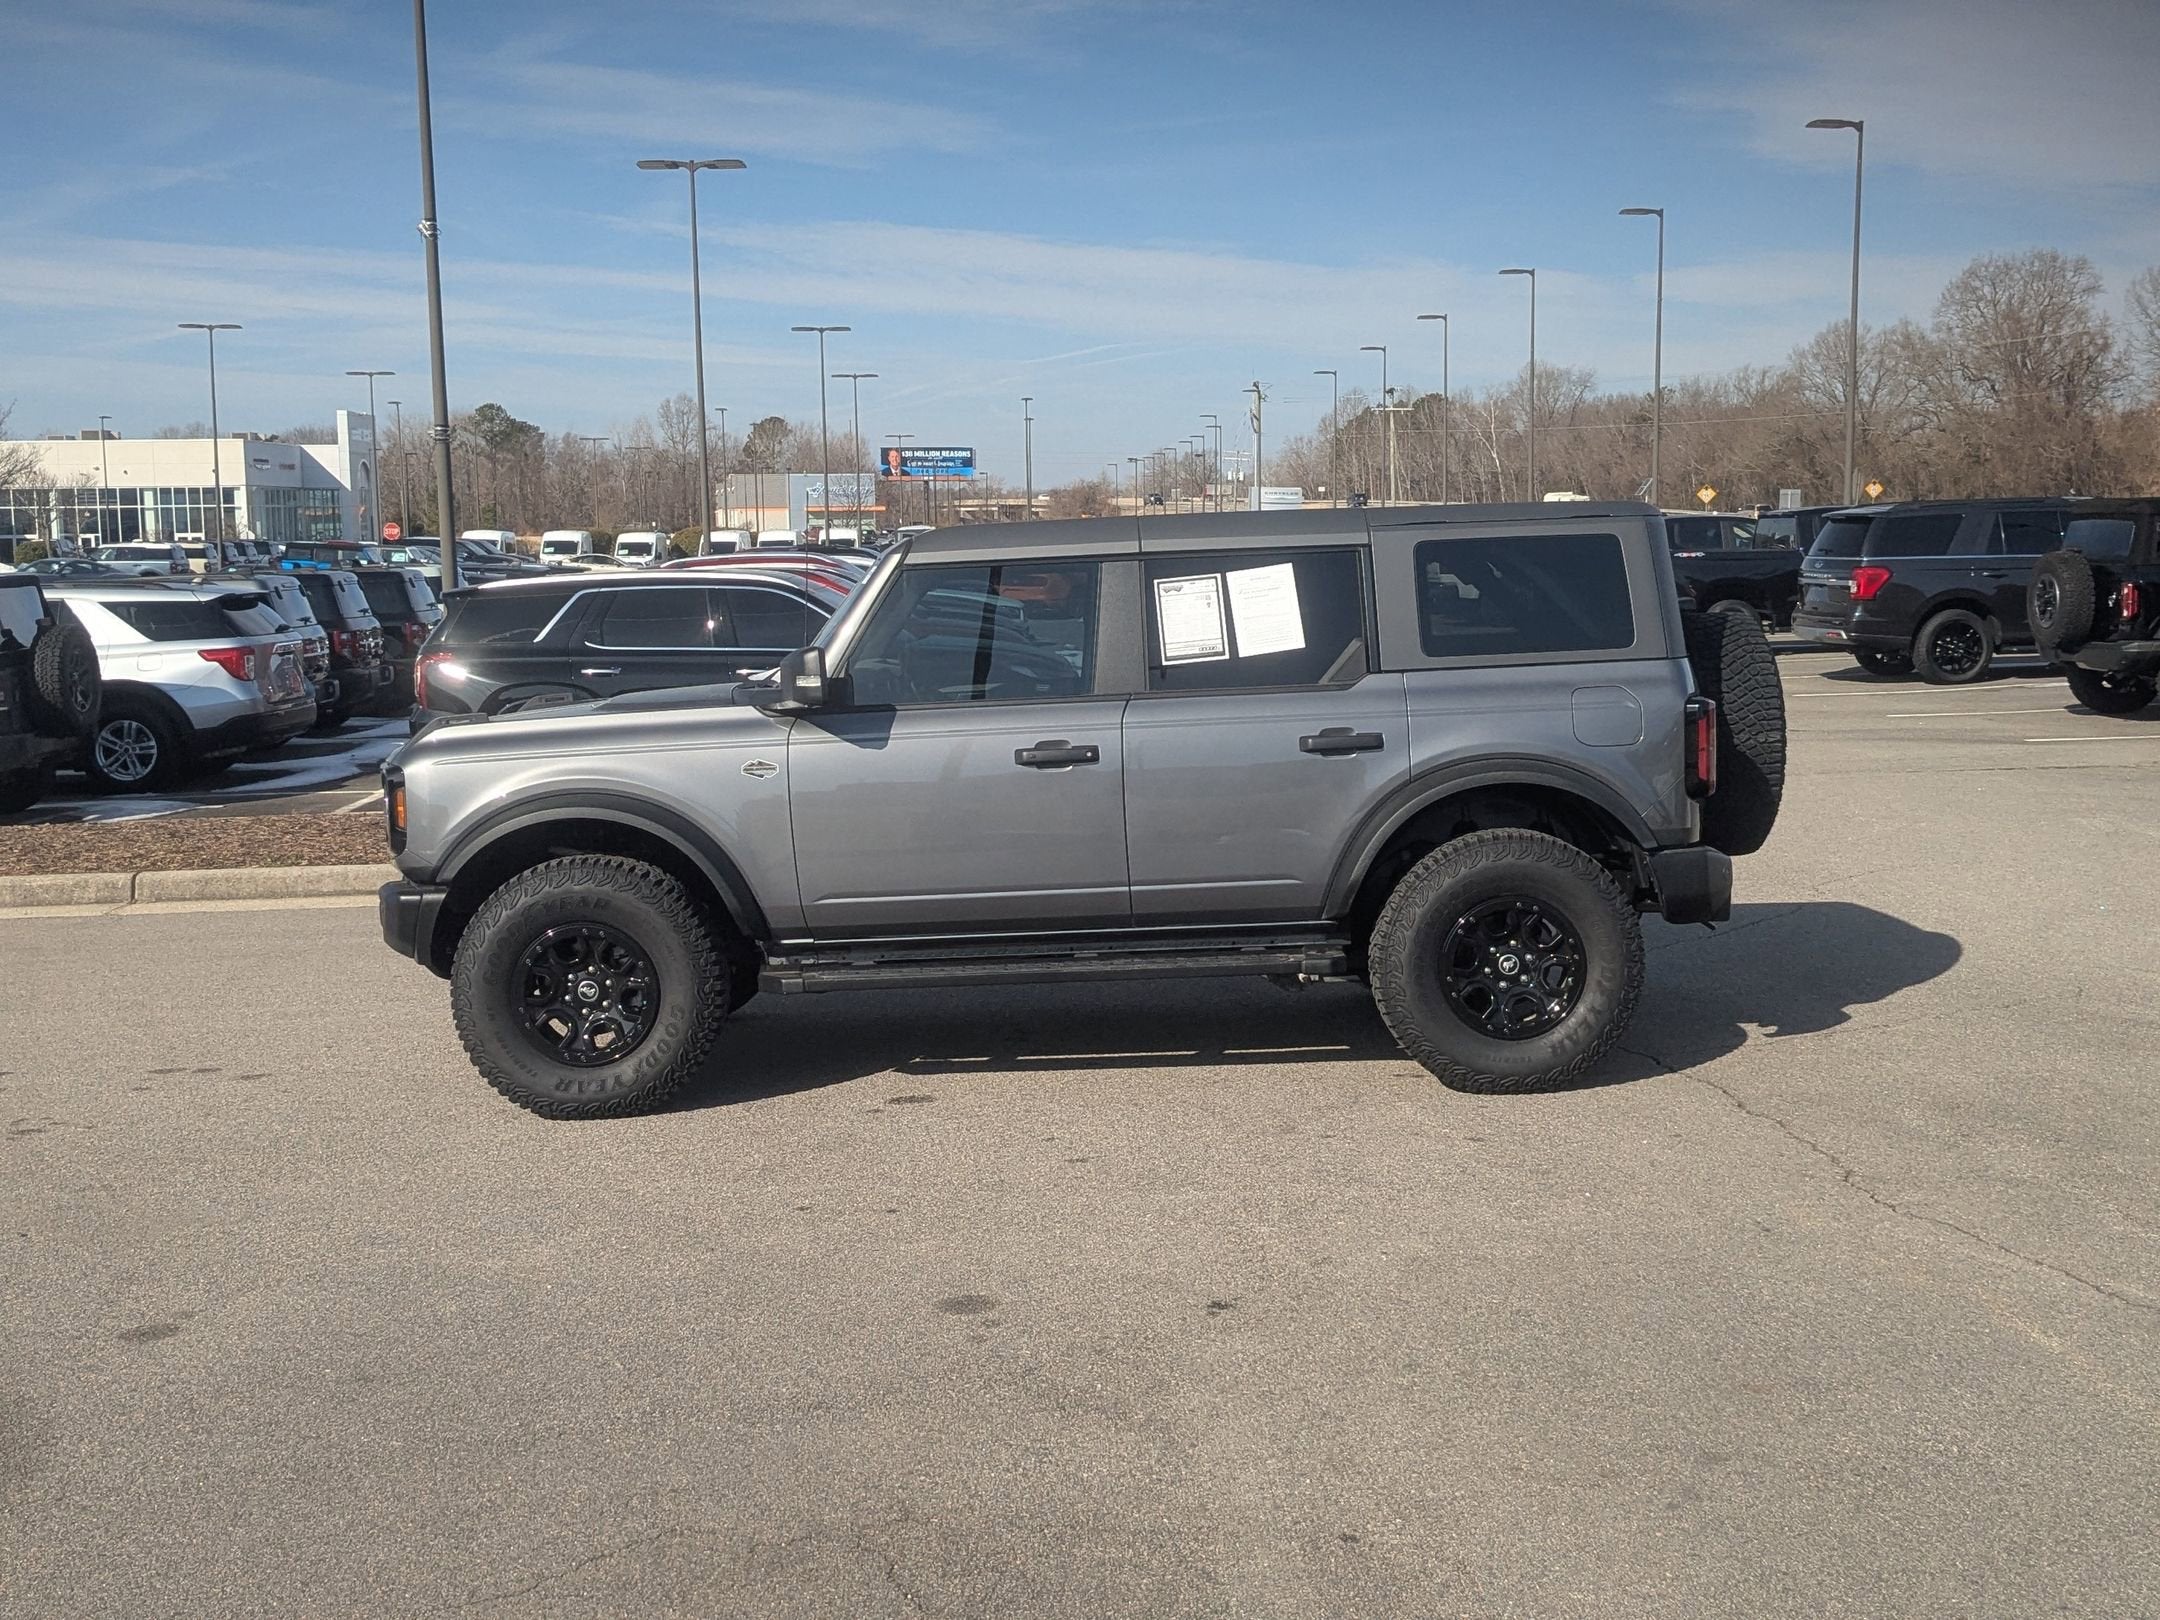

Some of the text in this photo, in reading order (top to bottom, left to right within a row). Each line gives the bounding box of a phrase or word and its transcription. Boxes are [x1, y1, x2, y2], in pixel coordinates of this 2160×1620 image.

[914, 450, 940, 458] MILLION
[941, 450, 971, 458] REASONS
[384, 527, 399, 535] STOP
